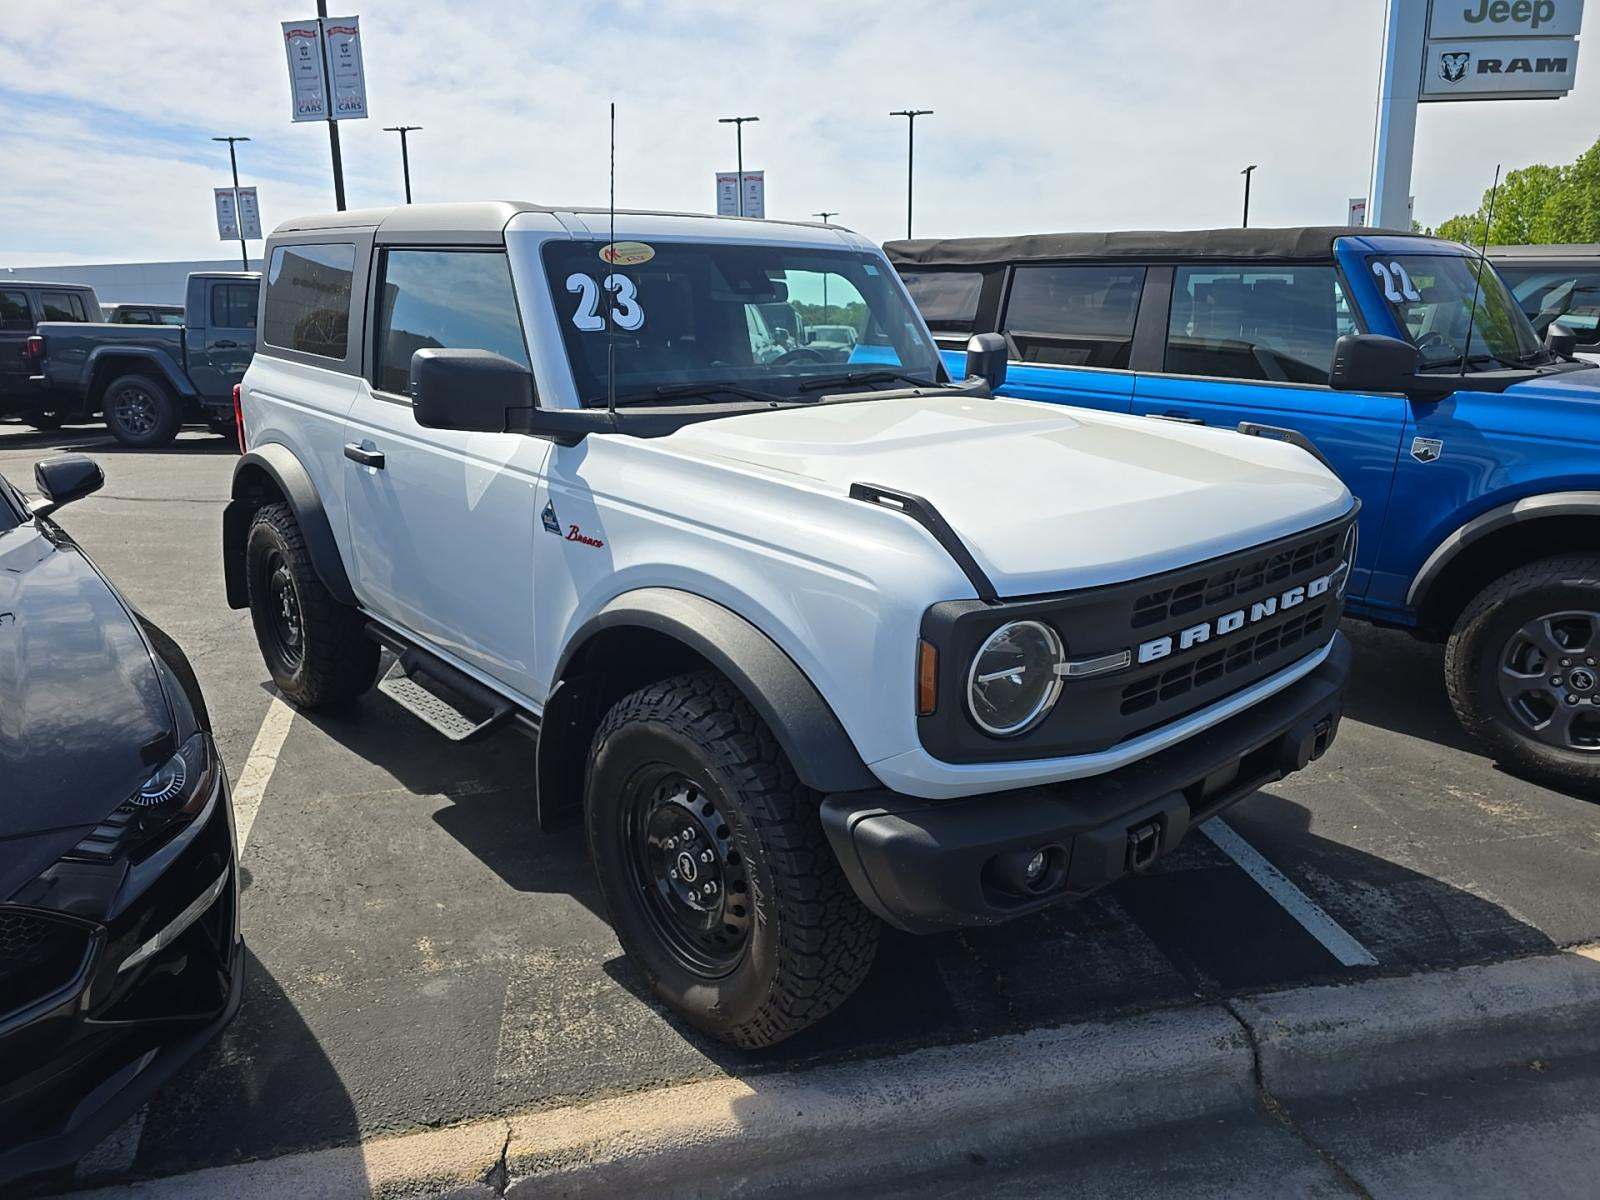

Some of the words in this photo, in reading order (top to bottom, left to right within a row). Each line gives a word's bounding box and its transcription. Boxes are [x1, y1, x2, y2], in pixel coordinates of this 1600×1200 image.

[1463, 0, 1555, 29] Jeep
[1477, 58, 1568, 74] RAM
[299, 104, 322, 113] CARS
[338, 102, 362, 111] CARS
[1372, 261, 1421, 303] 22
[565, 272, 645, 332] 23
[565, 524, 605, 548] Bronco
[1137, 575, 1331, 664] BRONCO
